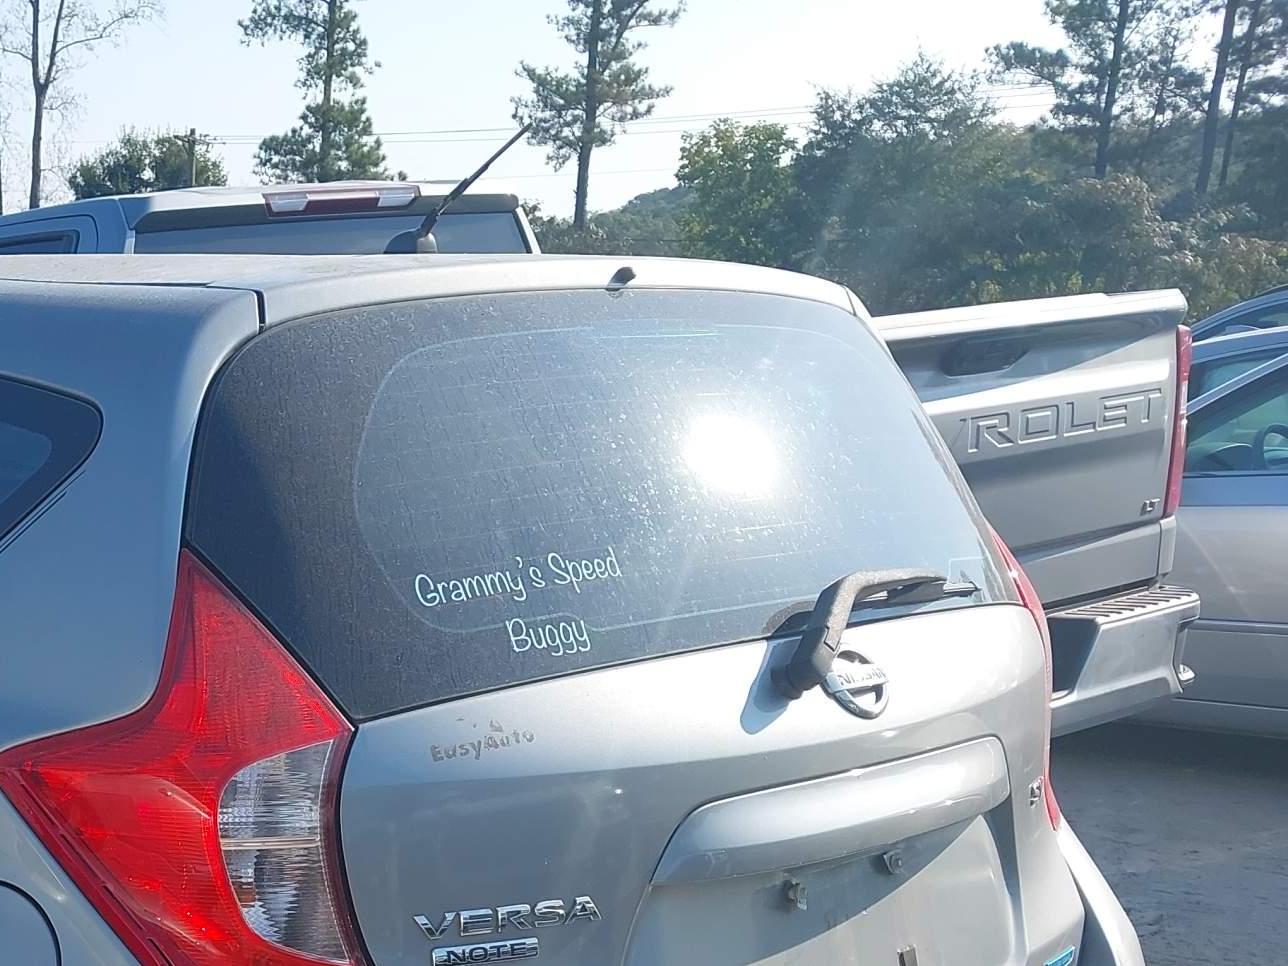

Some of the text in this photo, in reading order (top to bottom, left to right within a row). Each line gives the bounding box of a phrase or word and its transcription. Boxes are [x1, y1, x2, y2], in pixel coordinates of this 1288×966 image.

[955, 387, 1162, 453] ROLET
[414, 546, 622, 607] Grammy's Speed
[505, 617, 591, 656] Buggy
[412, 895, 602, 940] VERSA
[445, 941, 527, 964] NOTE
